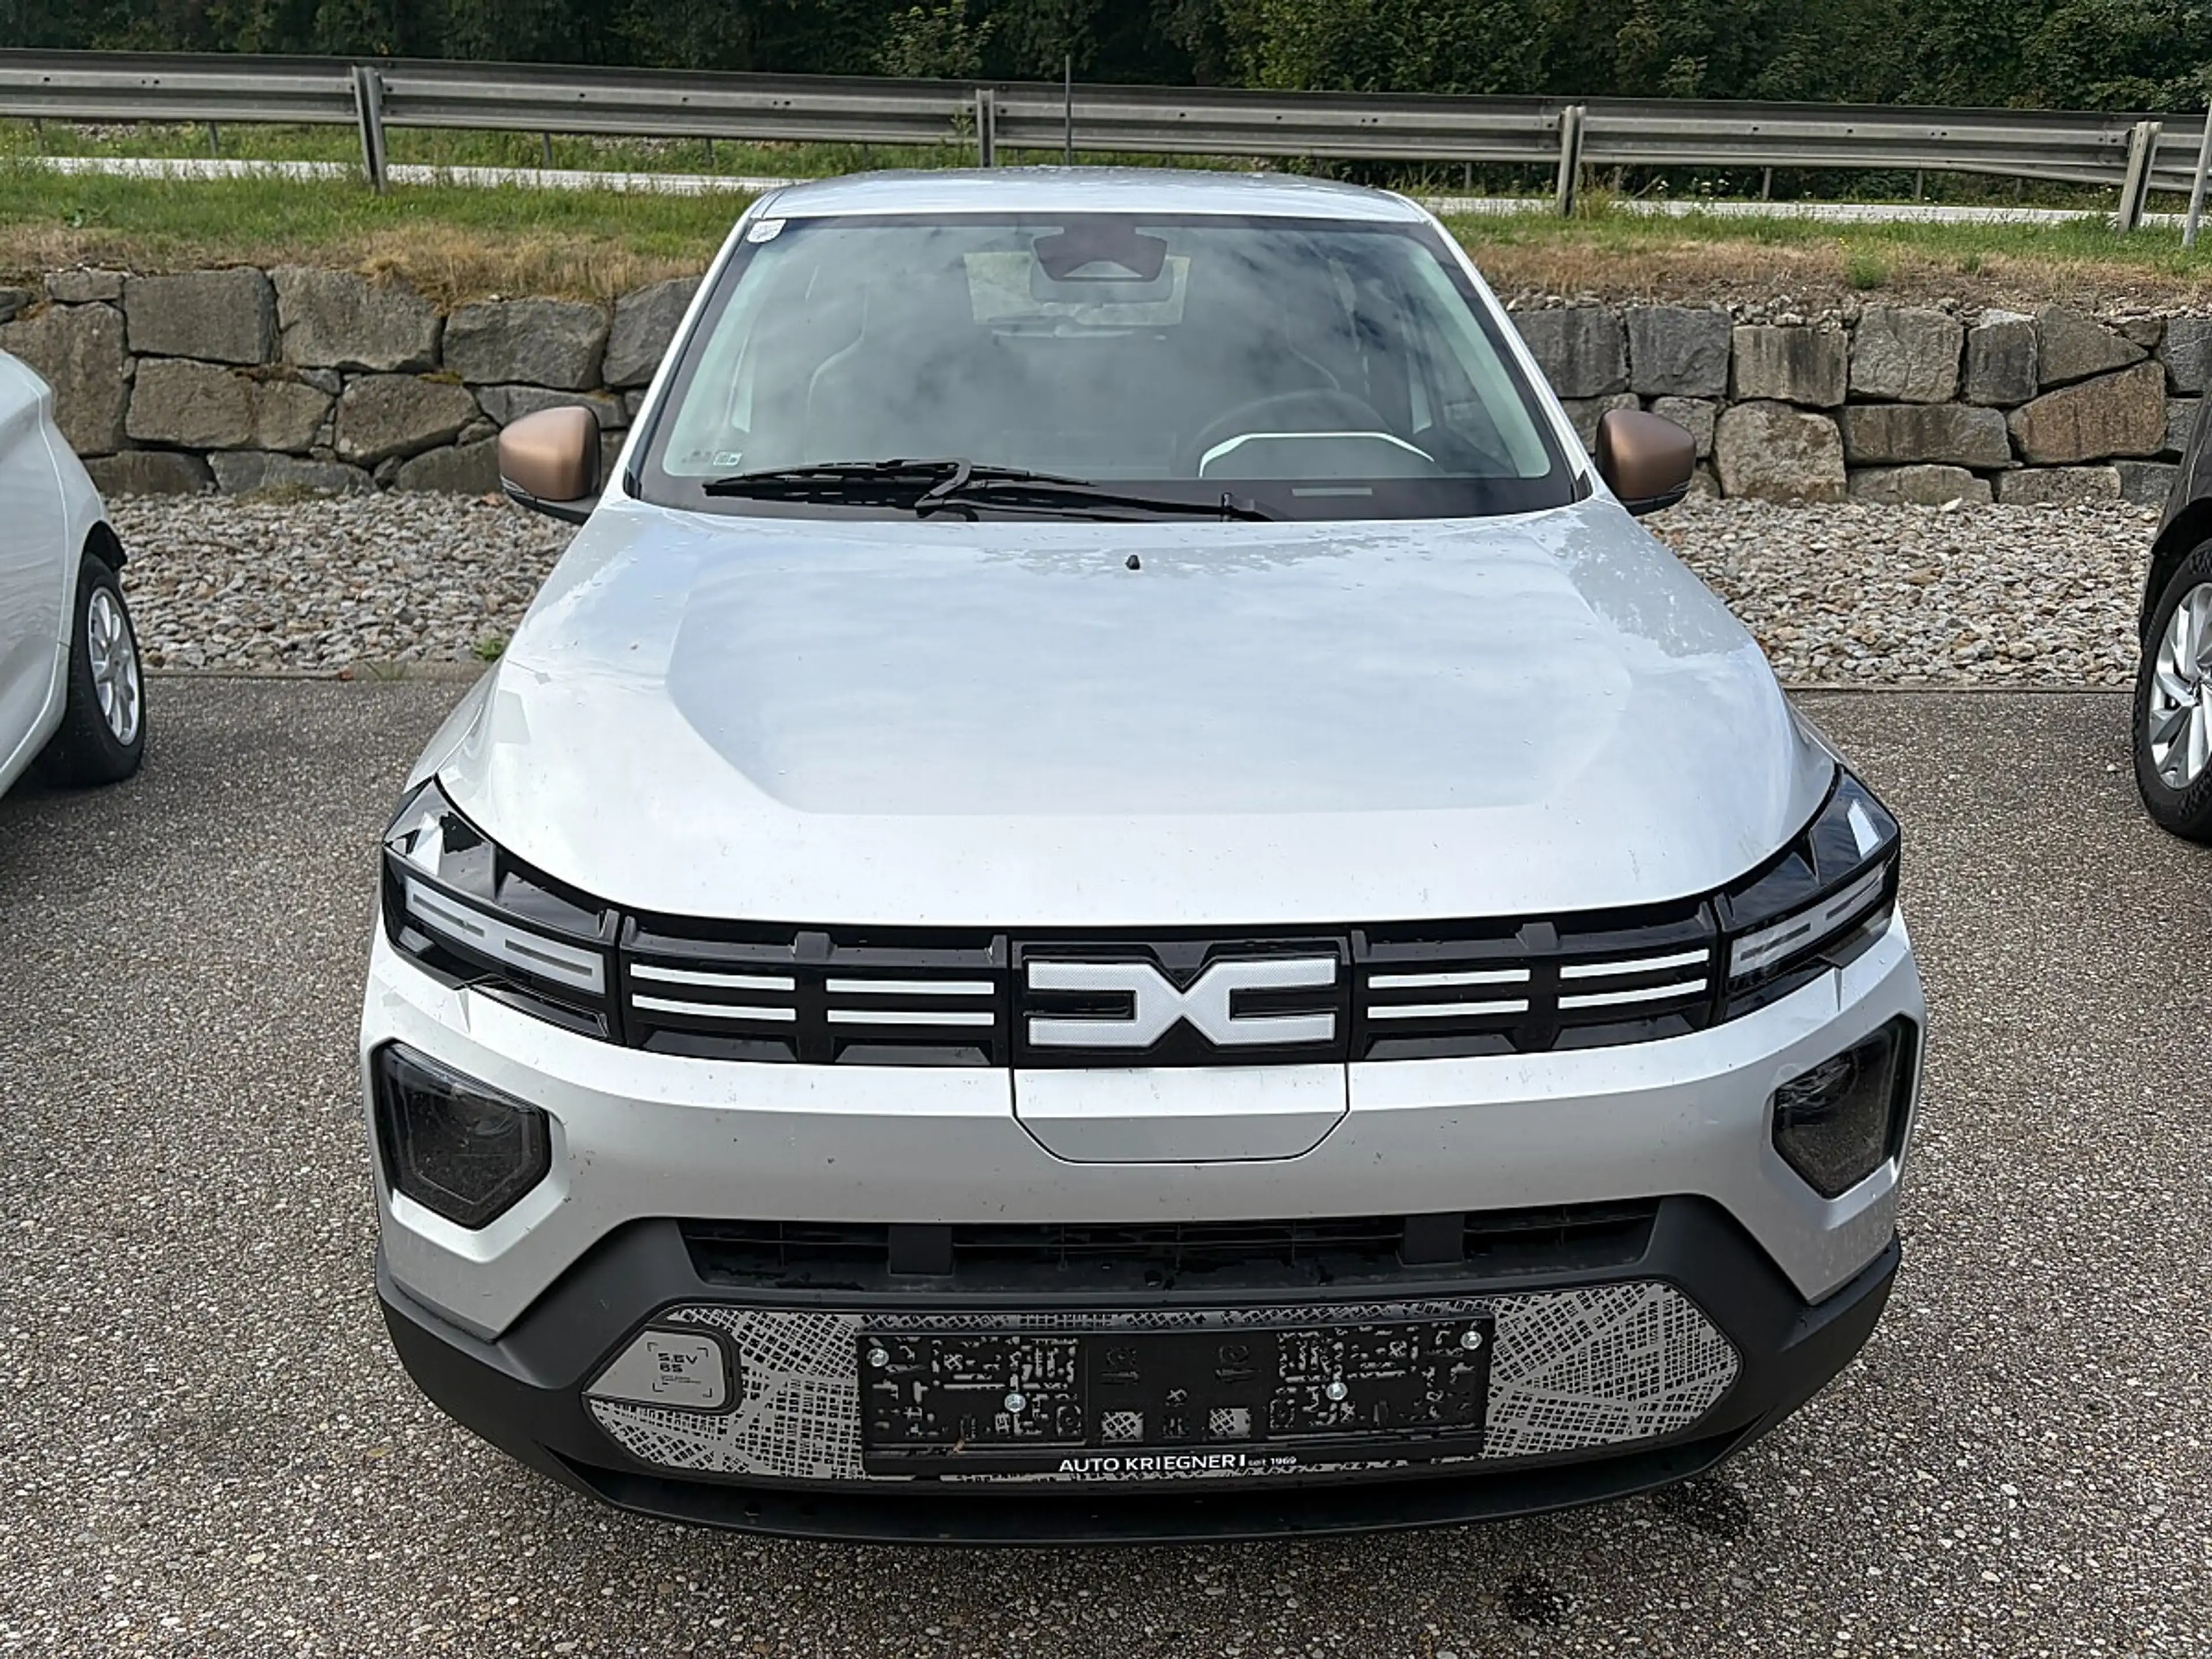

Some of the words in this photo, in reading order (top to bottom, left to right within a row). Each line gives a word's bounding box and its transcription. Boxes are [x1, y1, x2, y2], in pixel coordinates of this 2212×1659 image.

[1059, 1457, 1120, 1472] AUTO
[1126, 1454, 1236, 1471] KRIEGNER
[1270, 1456, 1297, 1465] 1969
